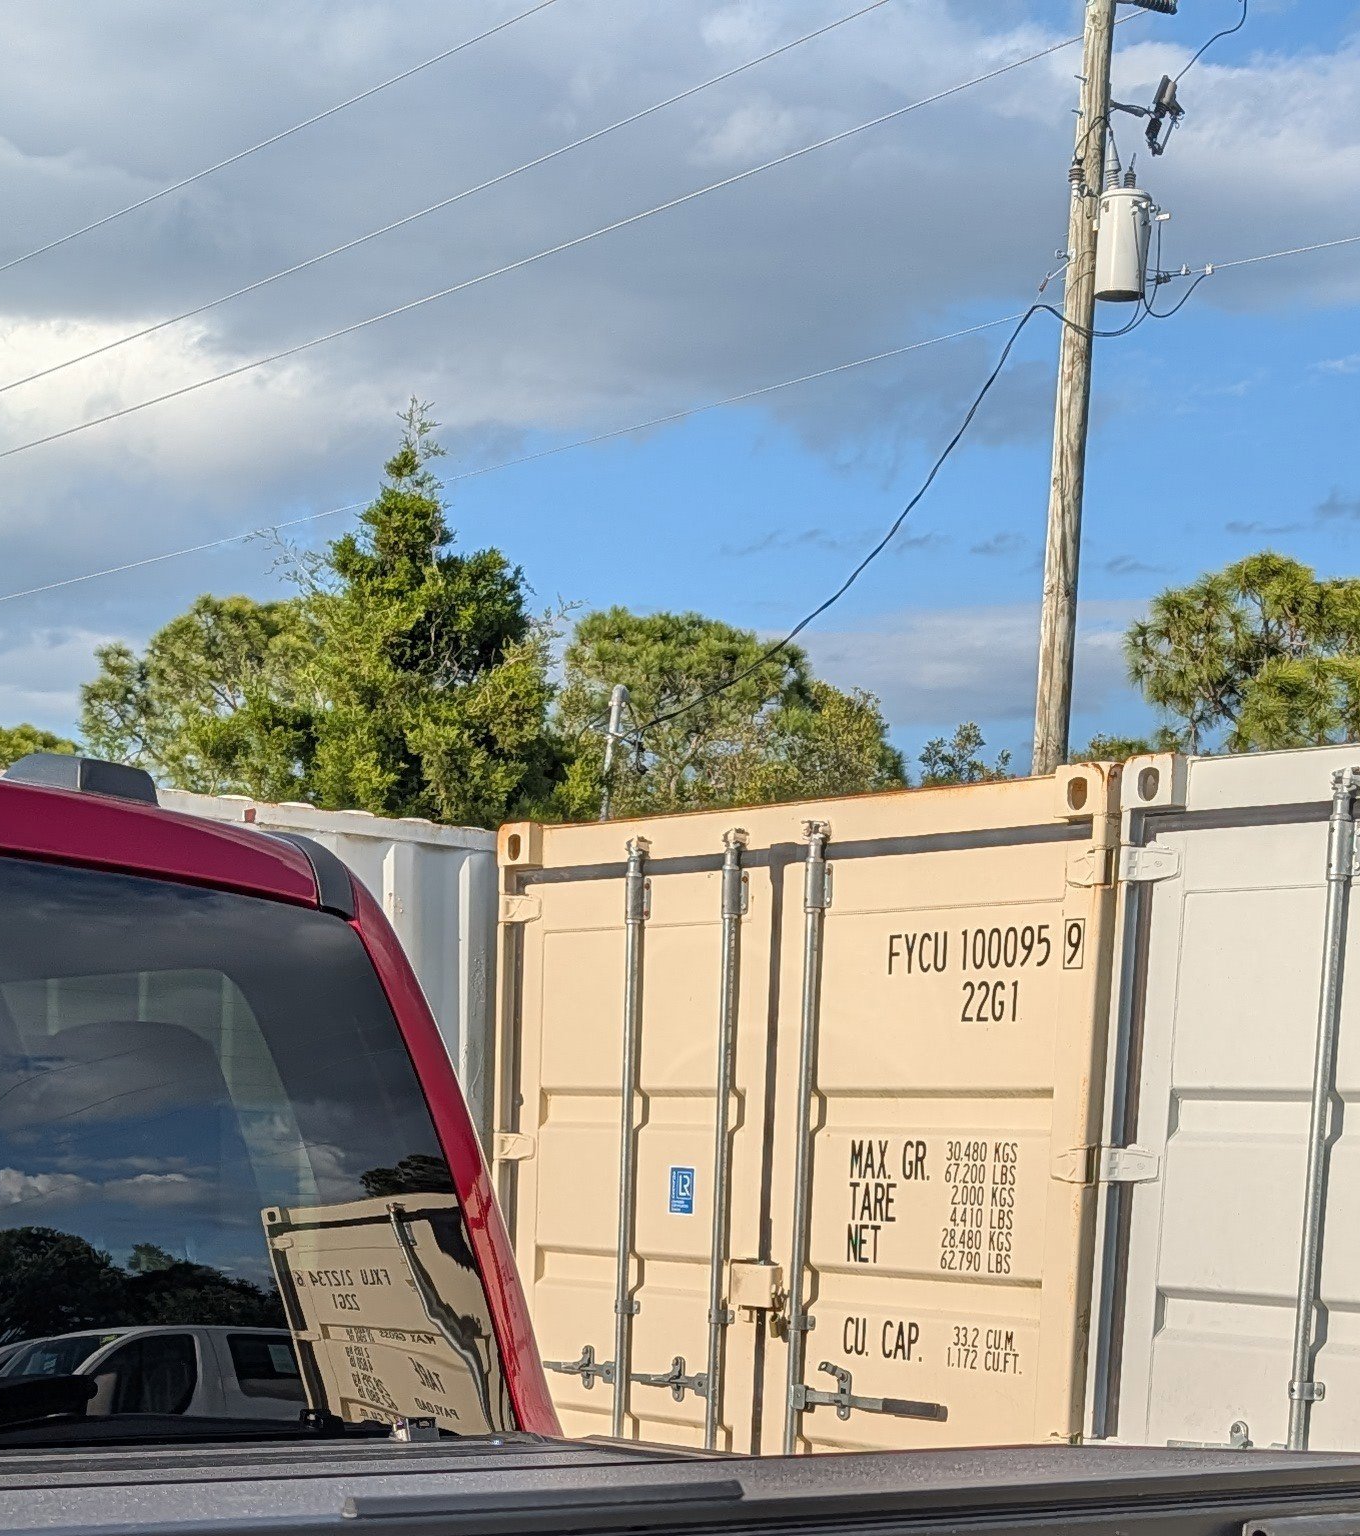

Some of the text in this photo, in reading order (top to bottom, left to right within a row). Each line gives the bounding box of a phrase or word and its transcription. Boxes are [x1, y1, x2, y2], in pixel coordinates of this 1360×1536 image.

[888, 922, 1083, 975] FYCU 100095 9
[961, 980, 1018, 1022] 22G1
[850, 1140, 891, 1179] MAX.
[903, 1141, 930, 1180] GR.
[994, 1142, 1018, 1163] KGS
[993, 1165, 1016, 1185] LBS
[849, 1182, 897, 1222] TARE
[991, 1187, 1014, 1208] KGS
[990, 1209, 1013, 1230] LBS
[847, 1224, 881, 1263] NET
[989, 1231, 1012, 1252] KGS
[988, 1253, 1011, 1274] LBS
[844, 1317, 1015, 1362] CU. CAP. 33.2 CU.M.
[985, 1348, 1022, 1374] CU.FT.
